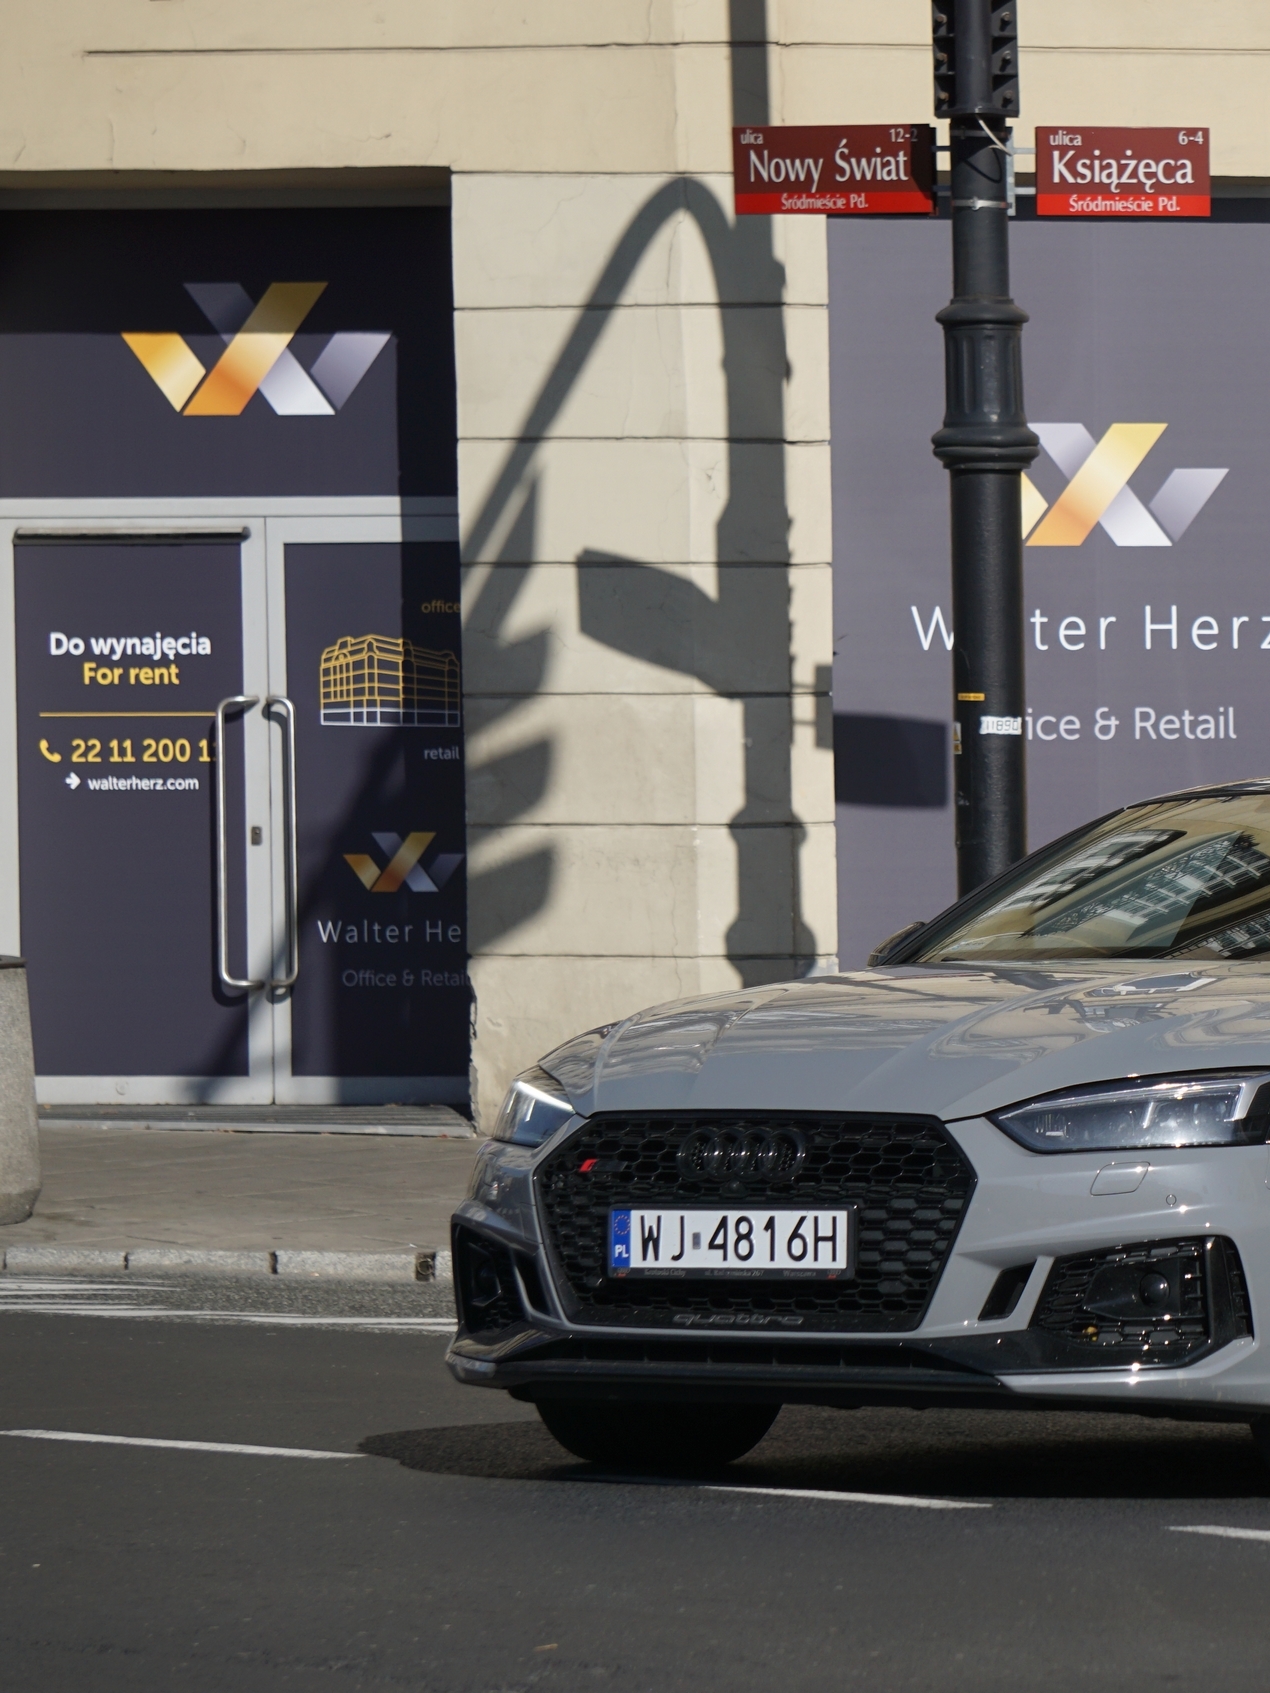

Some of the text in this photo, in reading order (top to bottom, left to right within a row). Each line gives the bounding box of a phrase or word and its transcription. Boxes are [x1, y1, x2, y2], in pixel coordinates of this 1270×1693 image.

[740, 129, 764, 145] ulica
[889, 128, 918, 142] 12-2
[1049, 130, 1082, 146] ulica
[1178, 131, 1204, 146] 6-4
[748, 139, 909, 192] Nowy Świat
[1052, 149, 1195, 193] Książęca
[781, 193, 869, 210] Śródmieście Pd.
[1069, 195, 1181, 213] Śródmieście Pd.
[421, 600, 461, 614] office
[910, 605, 1117, 651] Wter
[49, 632, 212, 661] Do wynajęcia
[83, 662, 180, 685] For rent
[1025, 707, 1237, 740] ice & Retail
[71, 738, 216, 763] 22 11 200 1
[424, 746, 460, 761] retail
[88, 774, 200, 791] walterherz.com
[317, 919, 462, 944] Walter He
[342, 969, 397, 987] Office
[402, 970, 415, 987] &
[640, 1215, 838, 1262] WJ 4816H
[614, 1245, 629, 1258] PL
[673, 1312, 804, 1326] quattro
